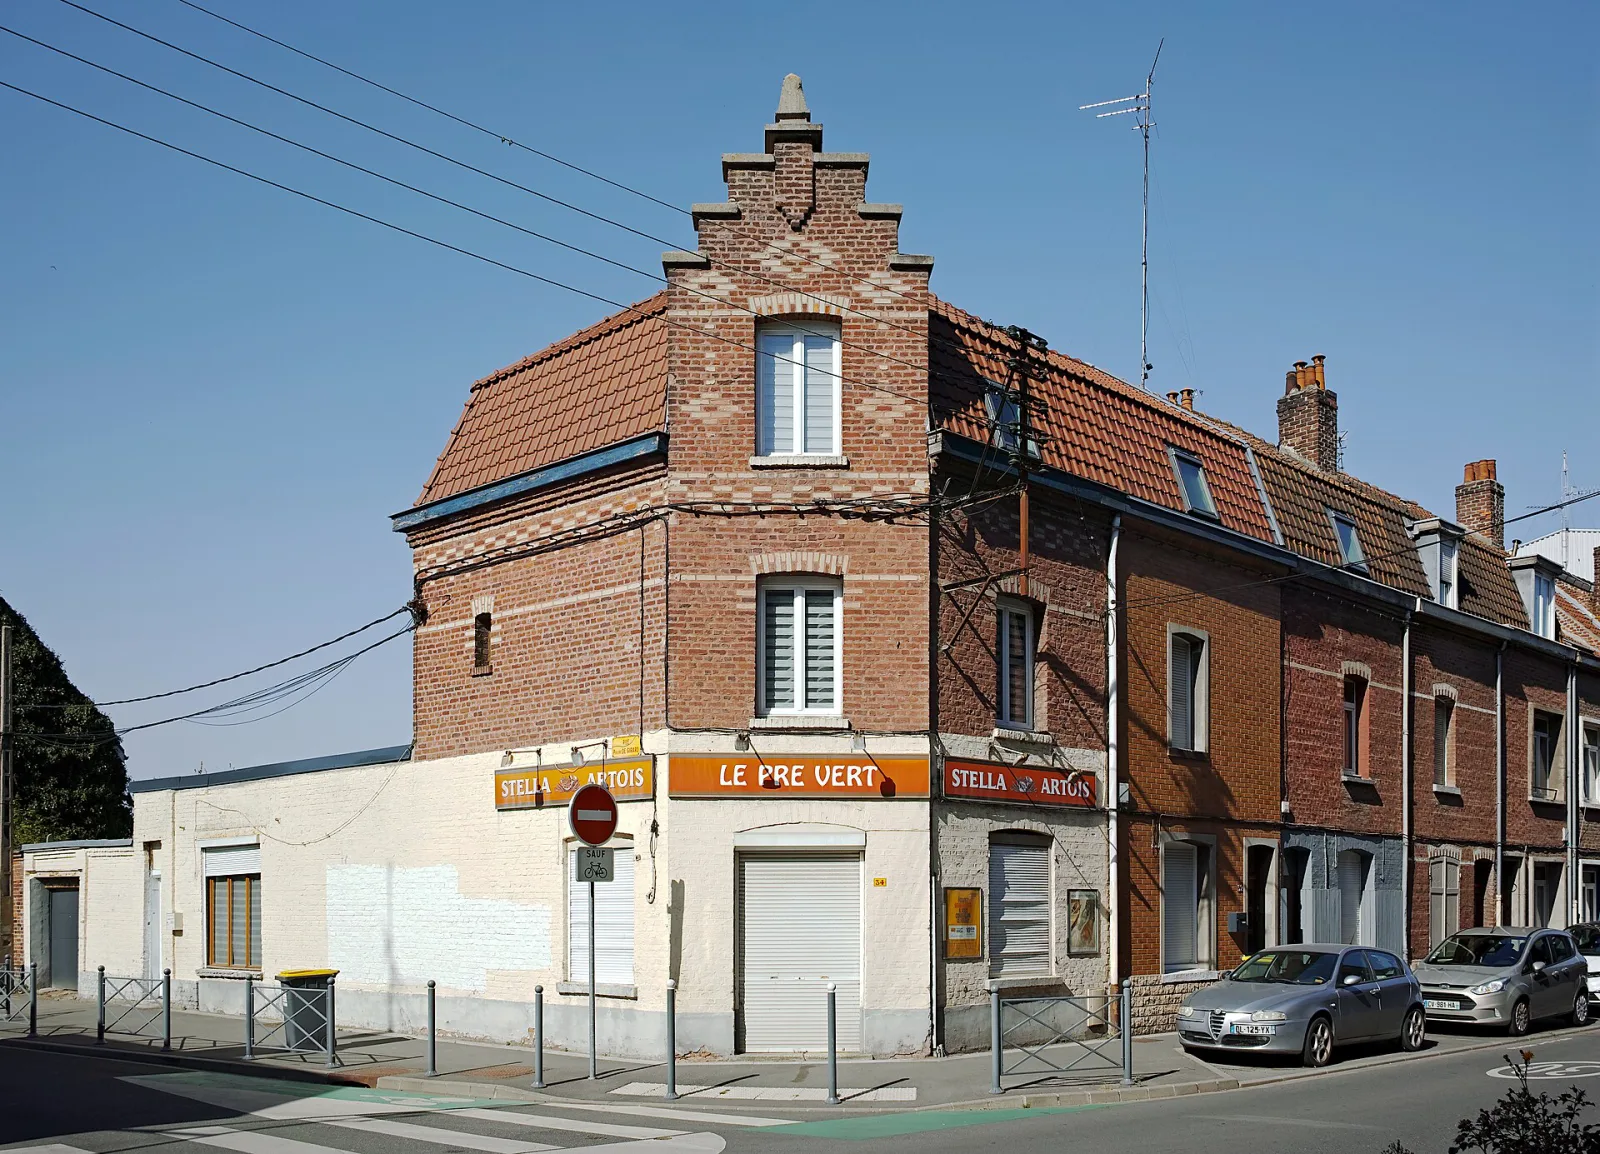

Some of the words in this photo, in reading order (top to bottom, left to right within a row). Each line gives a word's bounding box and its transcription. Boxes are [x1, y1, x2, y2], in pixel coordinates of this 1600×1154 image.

[501, 776, 552, 798] STELLA
[587, 767, 644, 788] ARTOIS
[719, 764, 748, 786] LE
[758, 764, 805, 787] PRE
[814, 765, 878, 787] VERT
[951, 768, 1007, 791] STELLA
[1040, 777, 1090, 798] ARTOIS
[586, 850, 606, 858] SAUF
